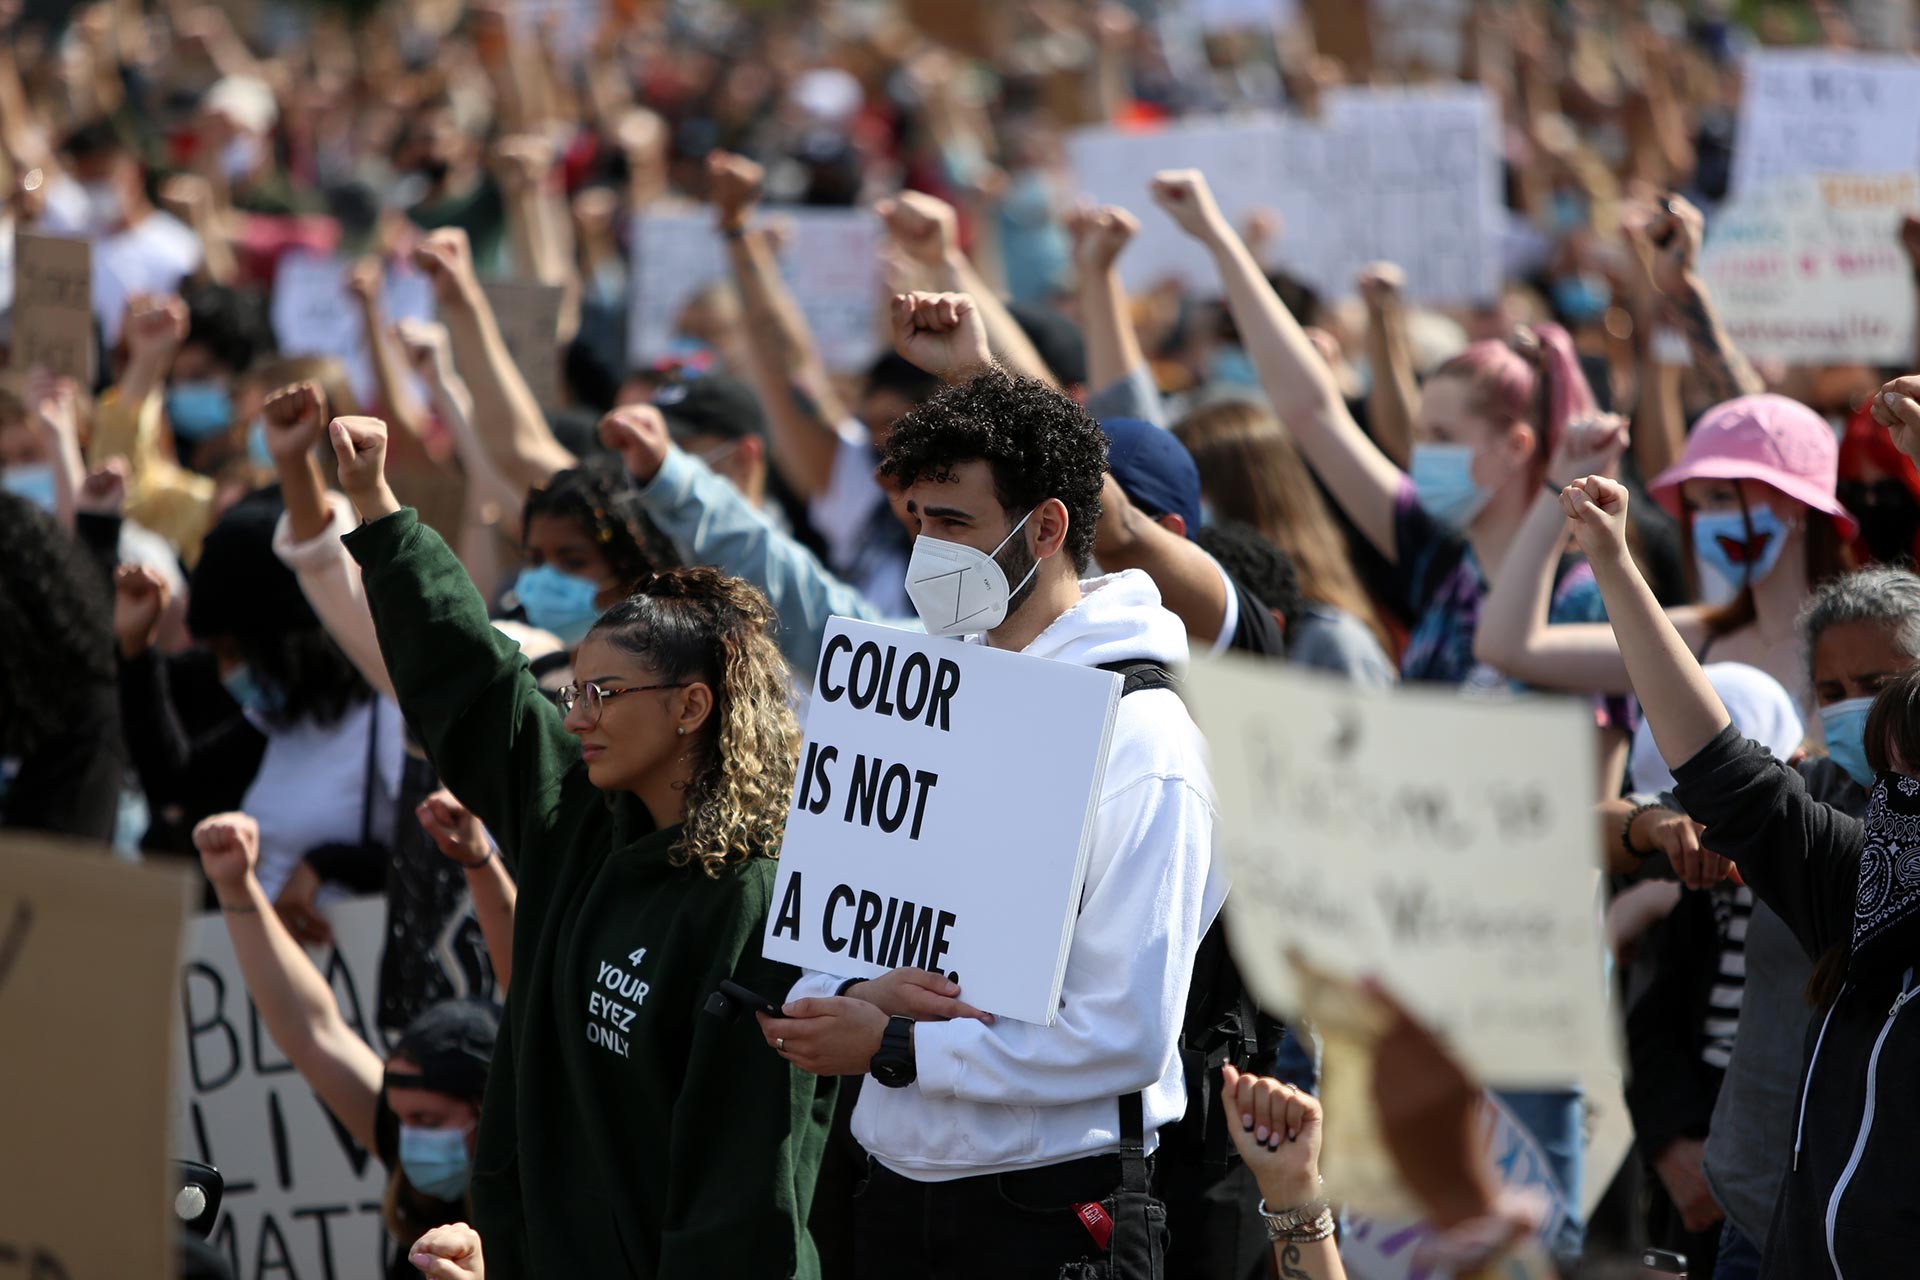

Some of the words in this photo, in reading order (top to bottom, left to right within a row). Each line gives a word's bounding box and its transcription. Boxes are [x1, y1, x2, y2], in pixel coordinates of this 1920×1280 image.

[819, 633, 961, 732] COLOR
[797, 742, 839, 815] IS
[844, 754, 939, 841] NOT
[772, 871, 802, 942] A
[822, 883, 960, 985] CRIME.
[628, 947, 647, 967] 4
[597, 960, 650, 1006] YOUR
[589, 991, 637, 1033] EYEZ
[586, 1021, 630, 1059] ONLY
